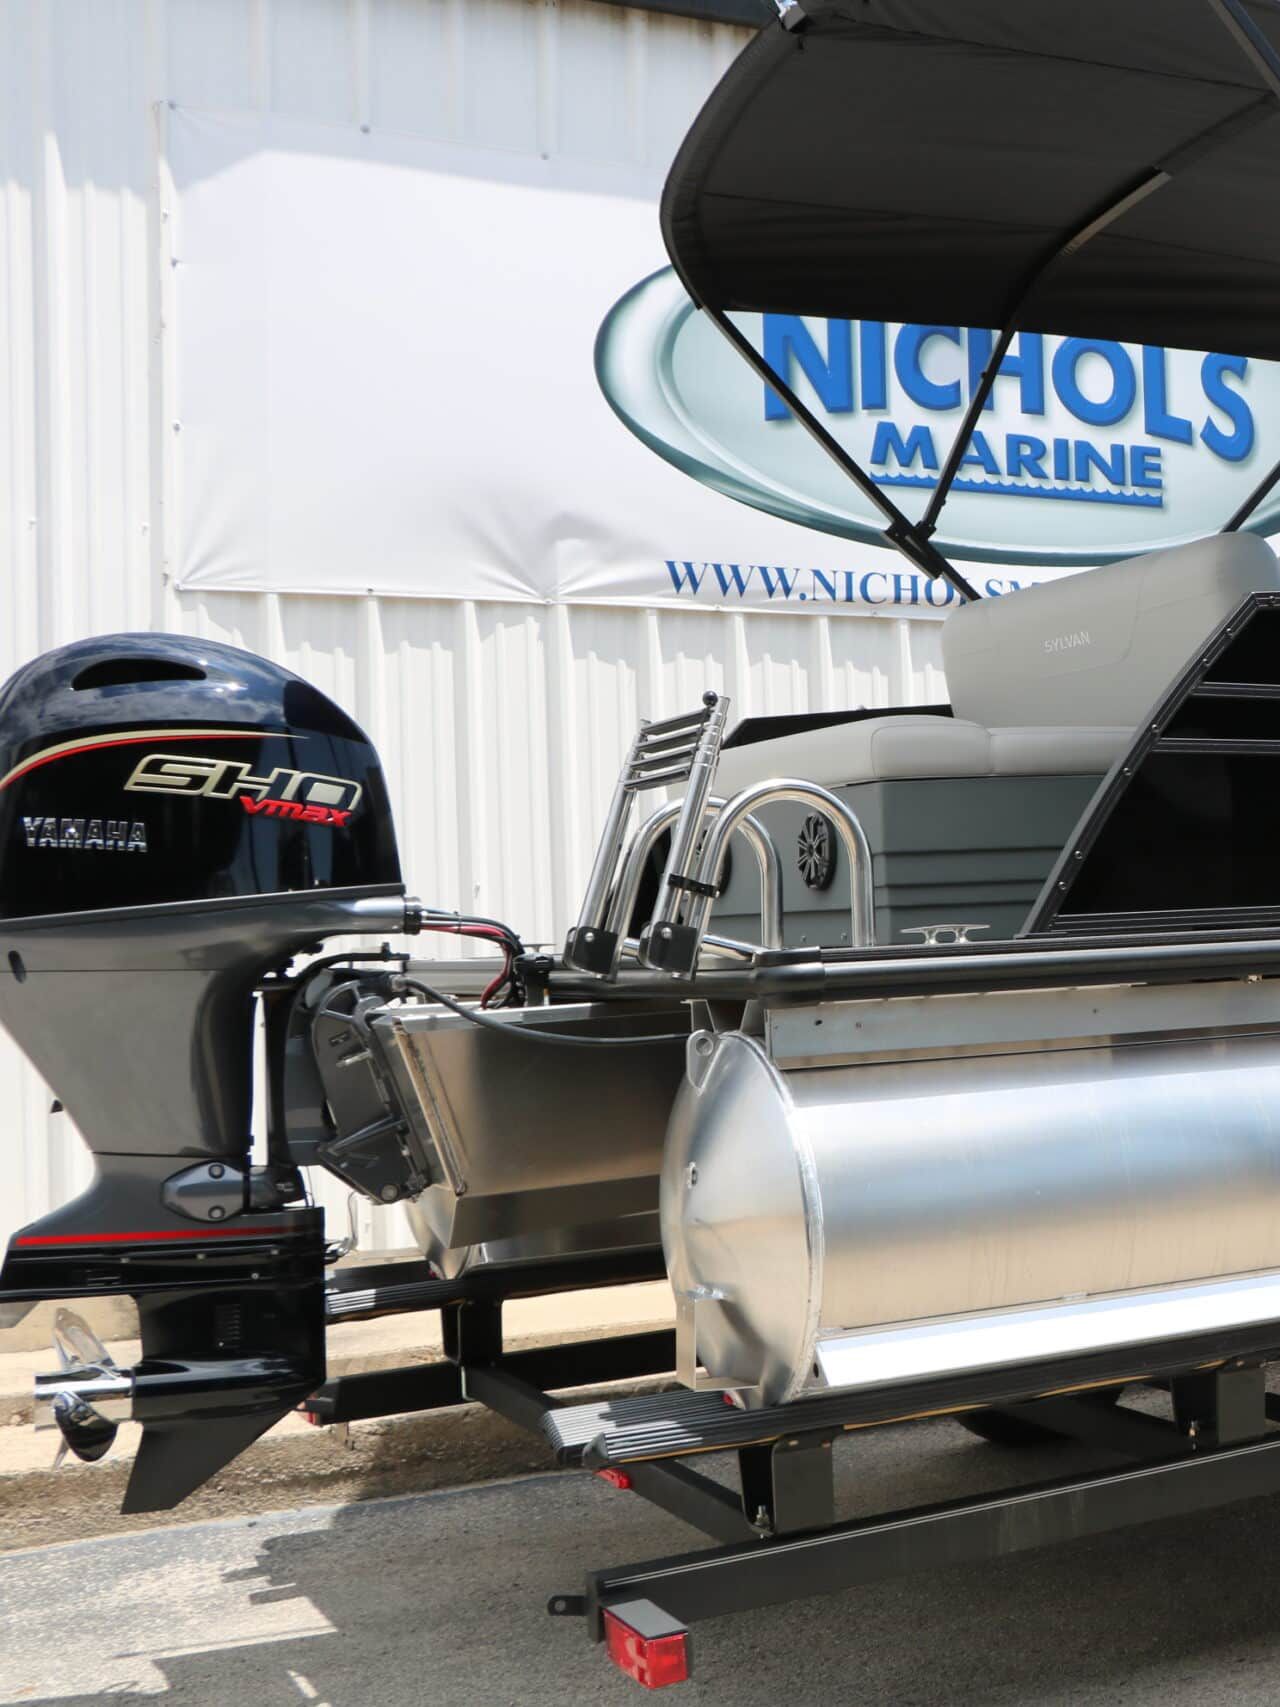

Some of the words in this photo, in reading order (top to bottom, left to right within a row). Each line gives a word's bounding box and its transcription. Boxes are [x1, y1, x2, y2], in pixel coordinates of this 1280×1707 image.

[763, 312, 1255, 463] NICHOLS
[870, 421, 1163, 488] MARINE
[665, 560, 1040, 607] WWW.NICHOS
[1044, 631, 1091, 653] SYLVAN
[123, 753, 363, 811] SHO
[23, 816, 148, 853] YAMAHA
